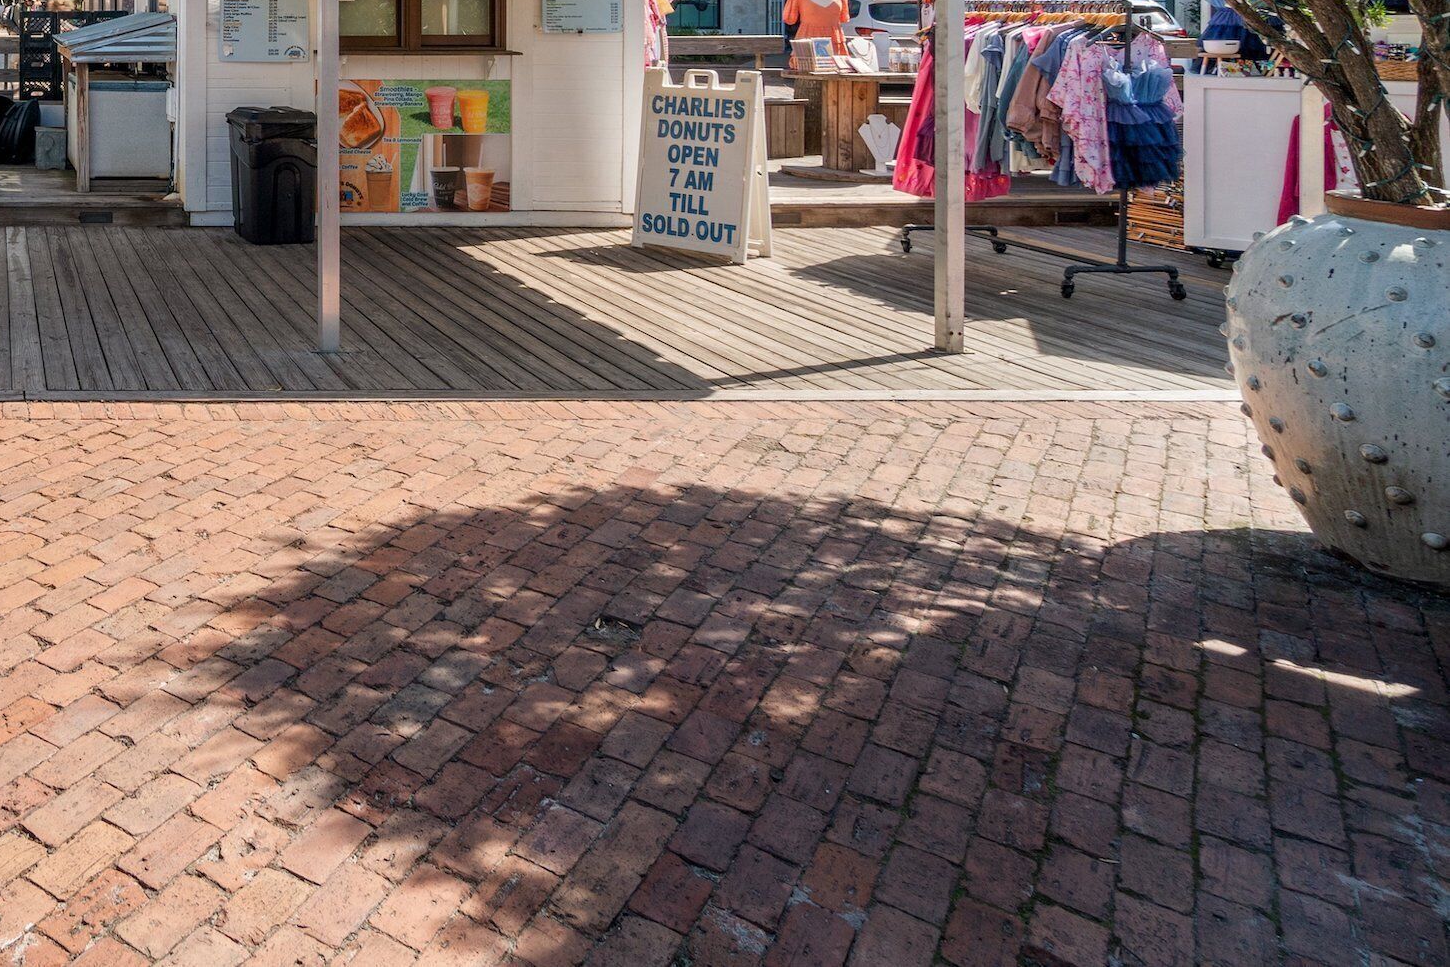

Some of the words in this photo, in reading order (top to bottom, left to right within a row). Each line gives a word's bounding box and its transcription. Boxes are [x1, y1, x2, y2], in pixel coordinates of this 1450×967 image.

[652, 95, 745, 120] CHARLIES
[657, 119, 735, 144] DONUTS
[667, 144, 719, 167] OPEN
[669, 168, 680, 187] 7
[684, 170, 714, 191] AM
[669, 192, 709, 215] TILL
[642, 212, 690, 237] SOLD
[695, 220, 737, 244] OUT
